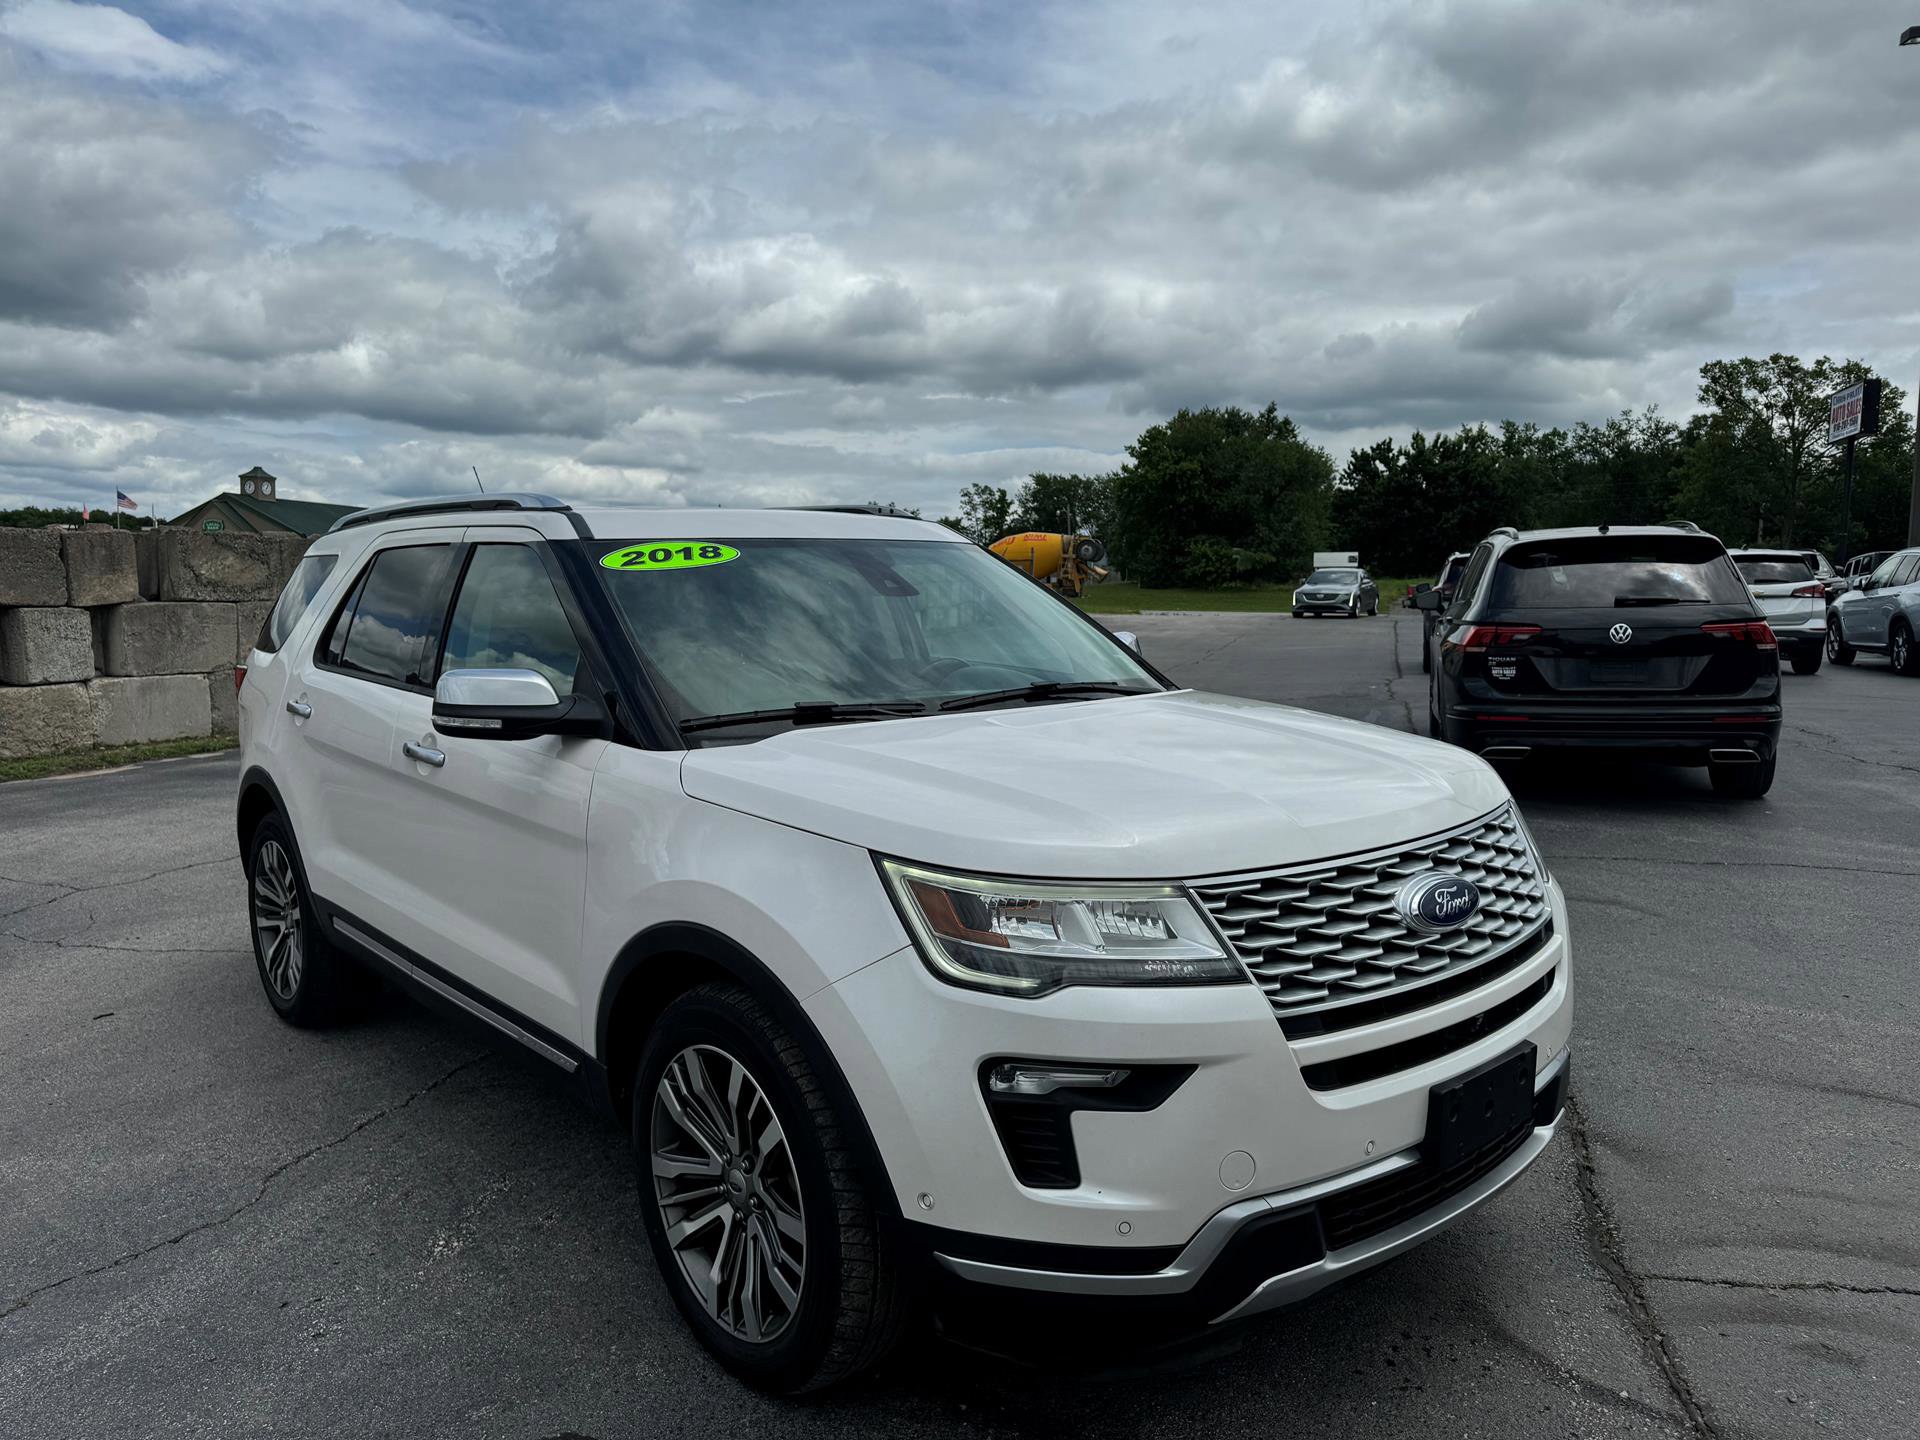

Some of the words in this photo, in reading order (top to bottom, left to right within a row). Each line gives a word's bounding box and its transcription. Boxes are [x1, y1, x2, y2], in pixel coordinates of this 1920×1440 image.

[1832, 403, 1846, 424] AUTO
[1847, 397, 1862, 418] SALES
[620, 545, 724, 567] 2018
[1435, 886, 1471, 919] Ford
